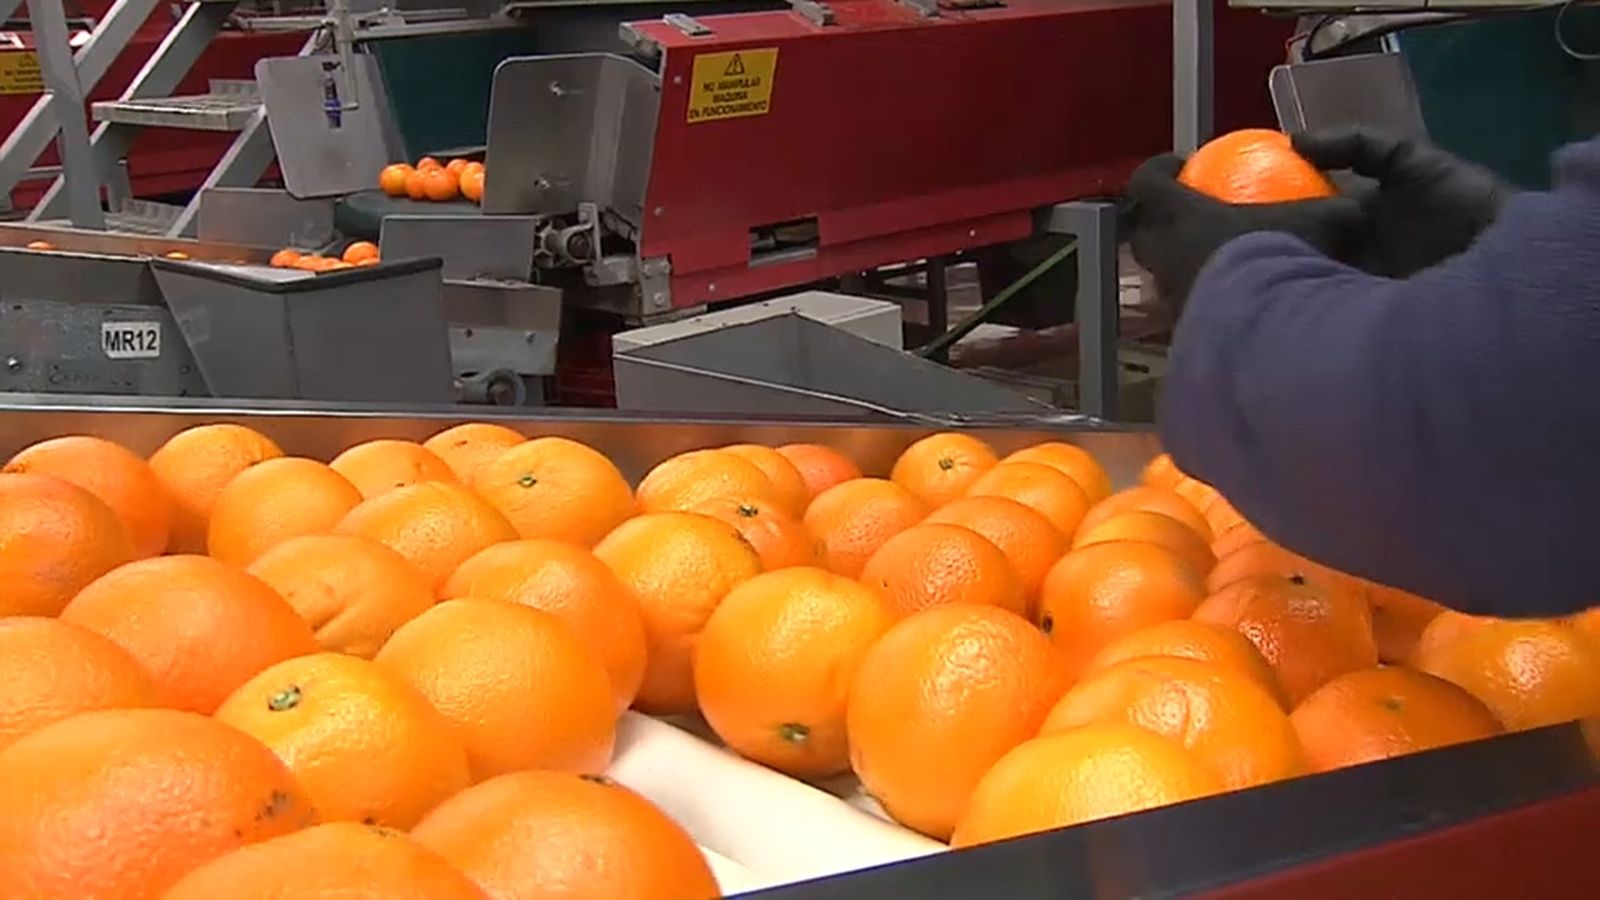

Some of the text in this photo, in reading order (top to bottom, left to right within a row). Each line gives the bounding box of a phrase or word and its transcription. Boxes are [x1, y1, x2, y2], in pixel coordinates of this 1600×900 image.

[703, 77, 761, 92] NO MANIPULAR
[689, 100, 767, 119] EN FUNCIONAMIENTO
[105, 330, 157, 351] MR12
